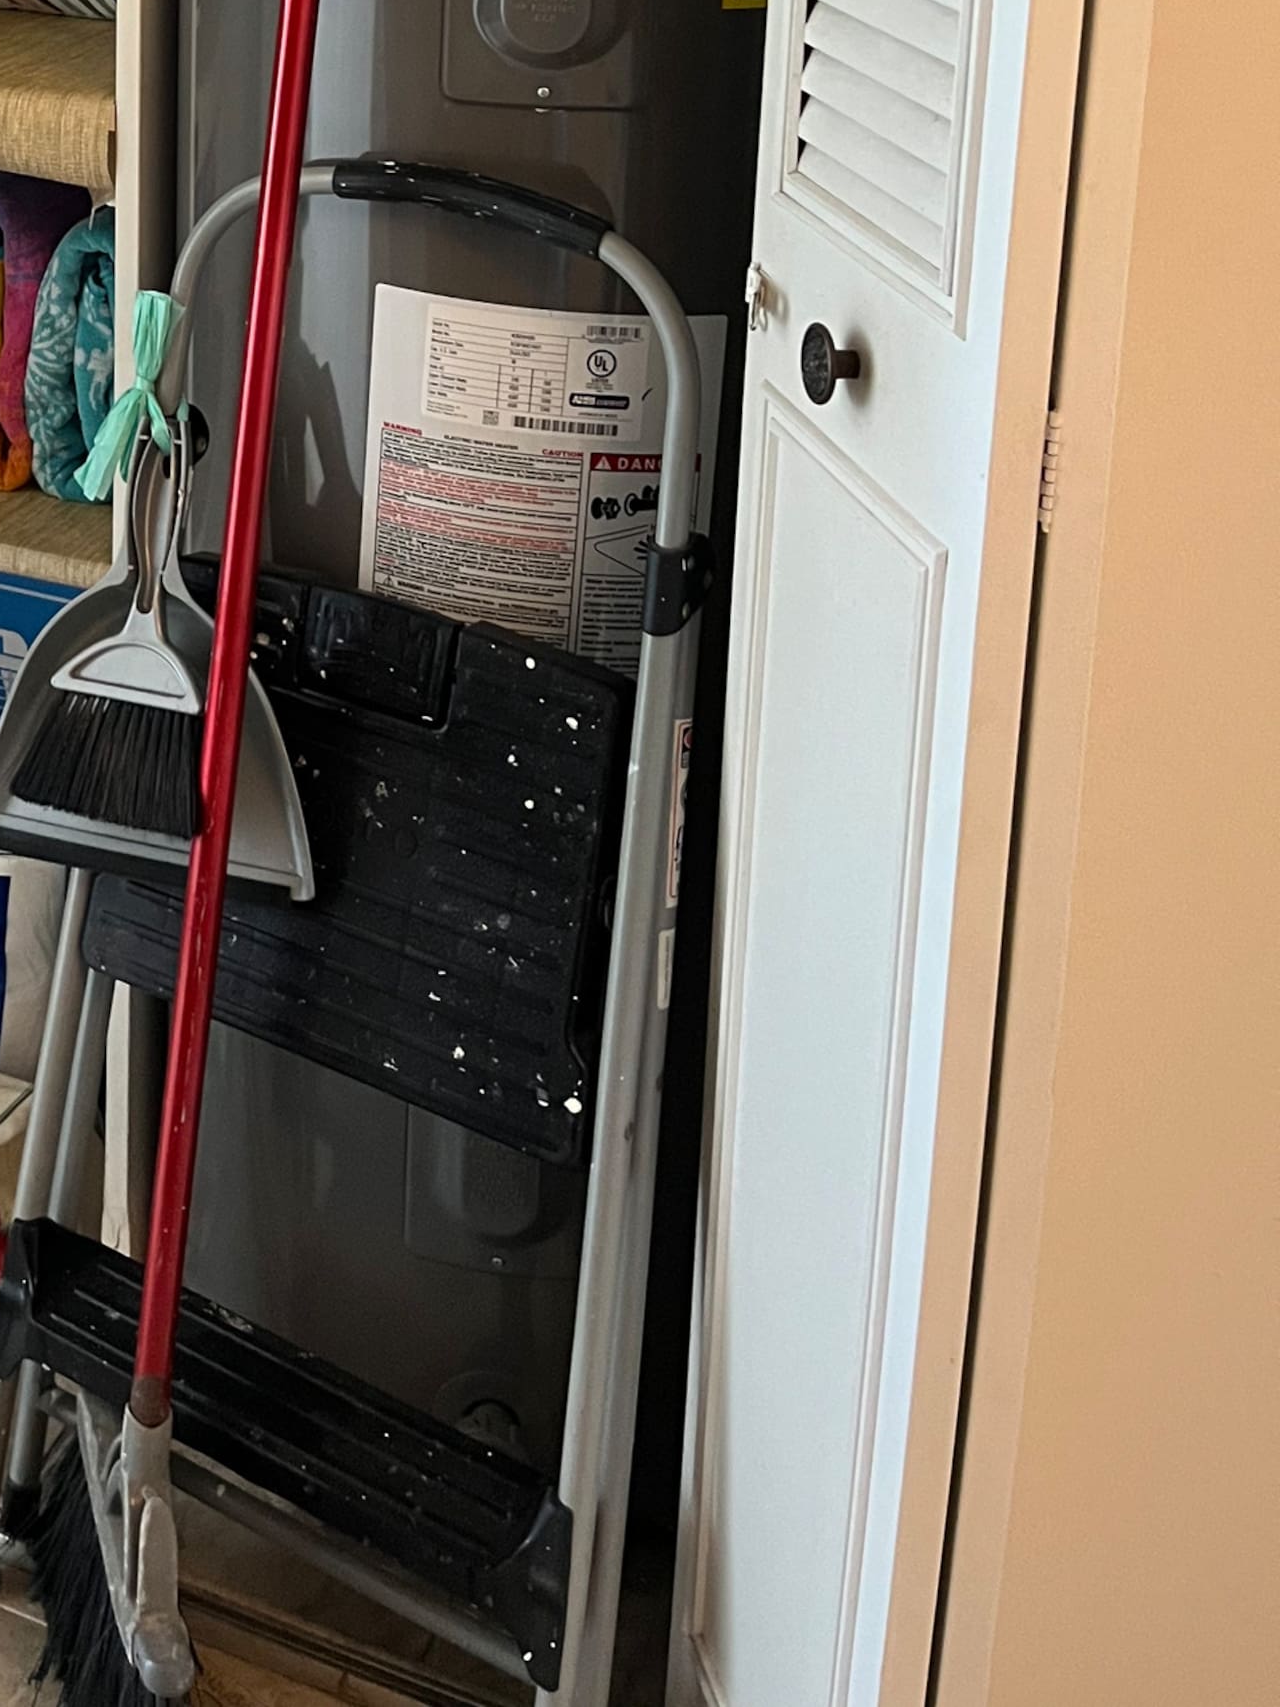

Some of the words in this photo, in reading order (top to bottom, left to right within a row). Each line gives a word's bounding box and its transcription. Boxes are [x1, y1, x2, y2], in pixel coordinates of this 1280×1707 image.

[594, 353, 609, 372] UL
[542, 448, 584, 457] CAUTION
[617, 456, 661, 471] DAN
